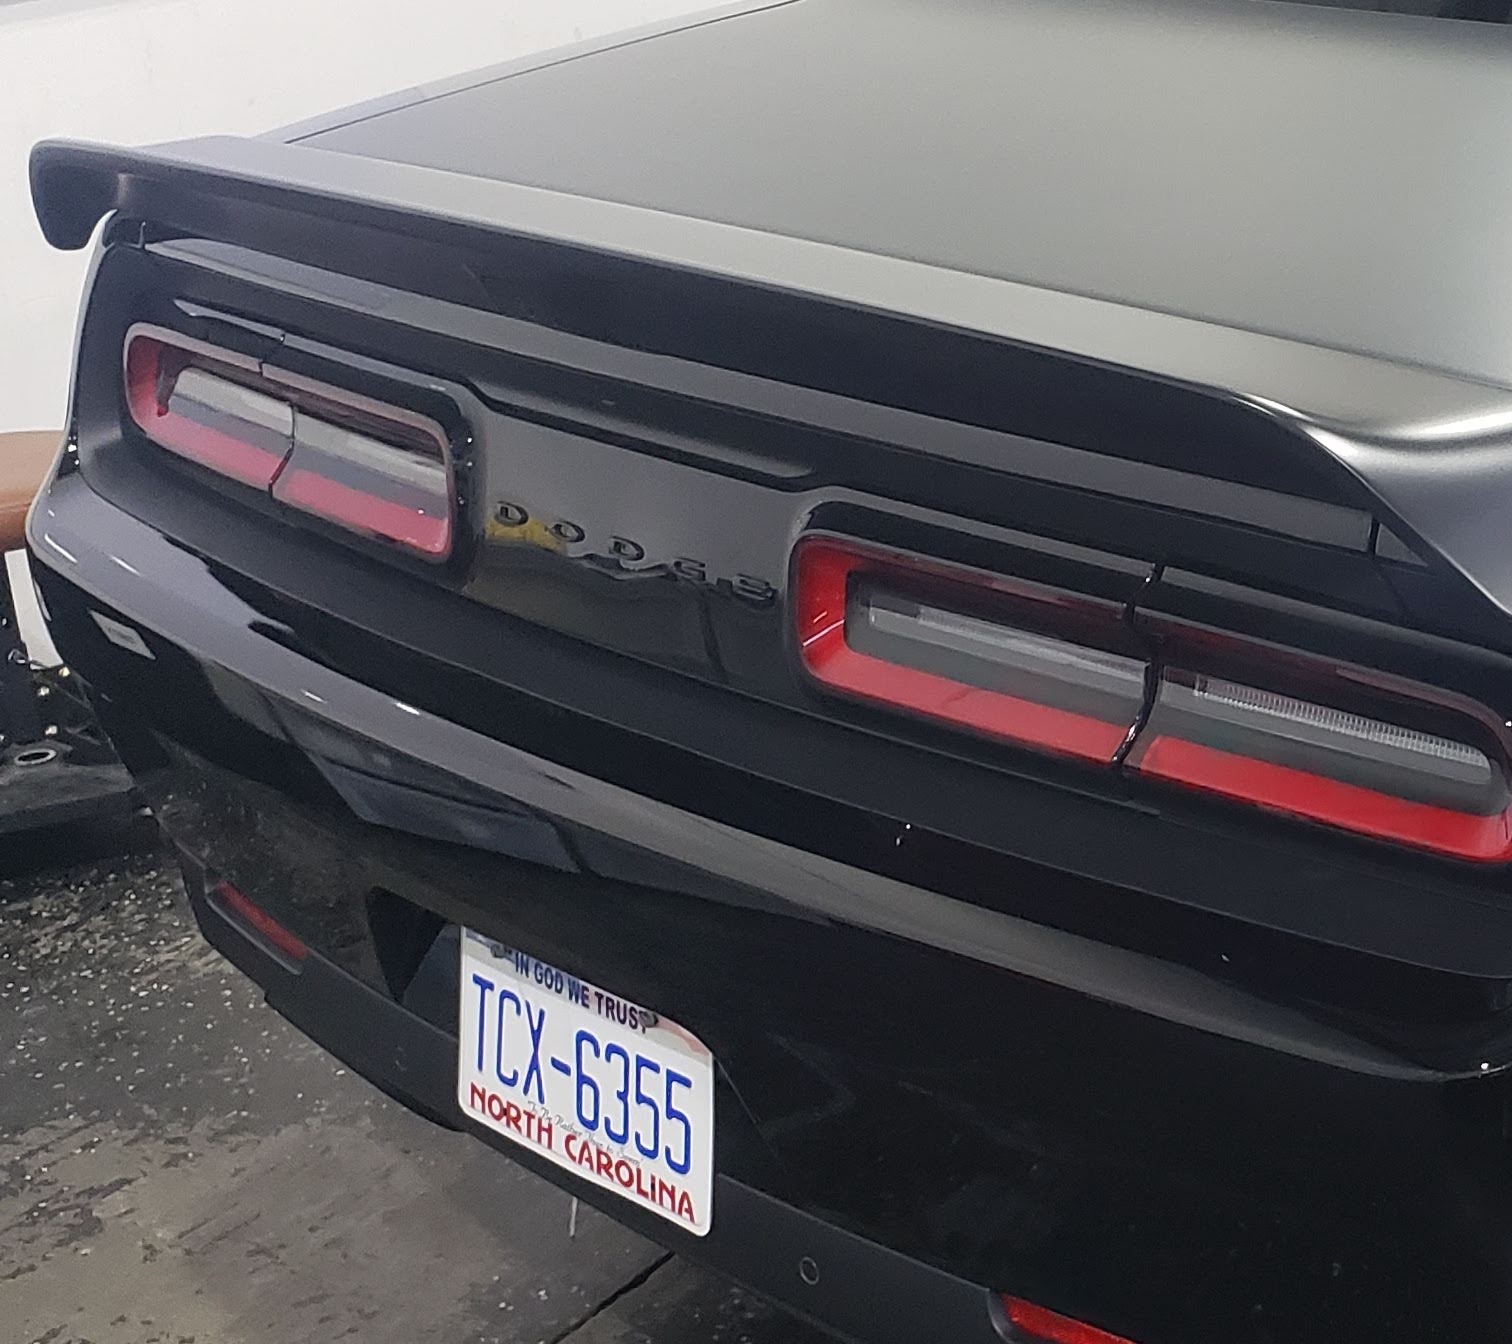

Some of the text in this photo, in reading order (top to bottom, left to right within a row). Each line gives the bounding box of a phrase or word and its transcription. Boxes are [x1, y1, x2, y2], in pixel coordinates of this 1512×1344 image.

[494, 500, 776, 604] DODGE
[534, 961, 564, 994] GOD
[568, 978, 590, 1009] WE
[472, 973, 693, 1176] TCX-6355
[469, 1082, 696, 1223] NORTH CAROLINA
